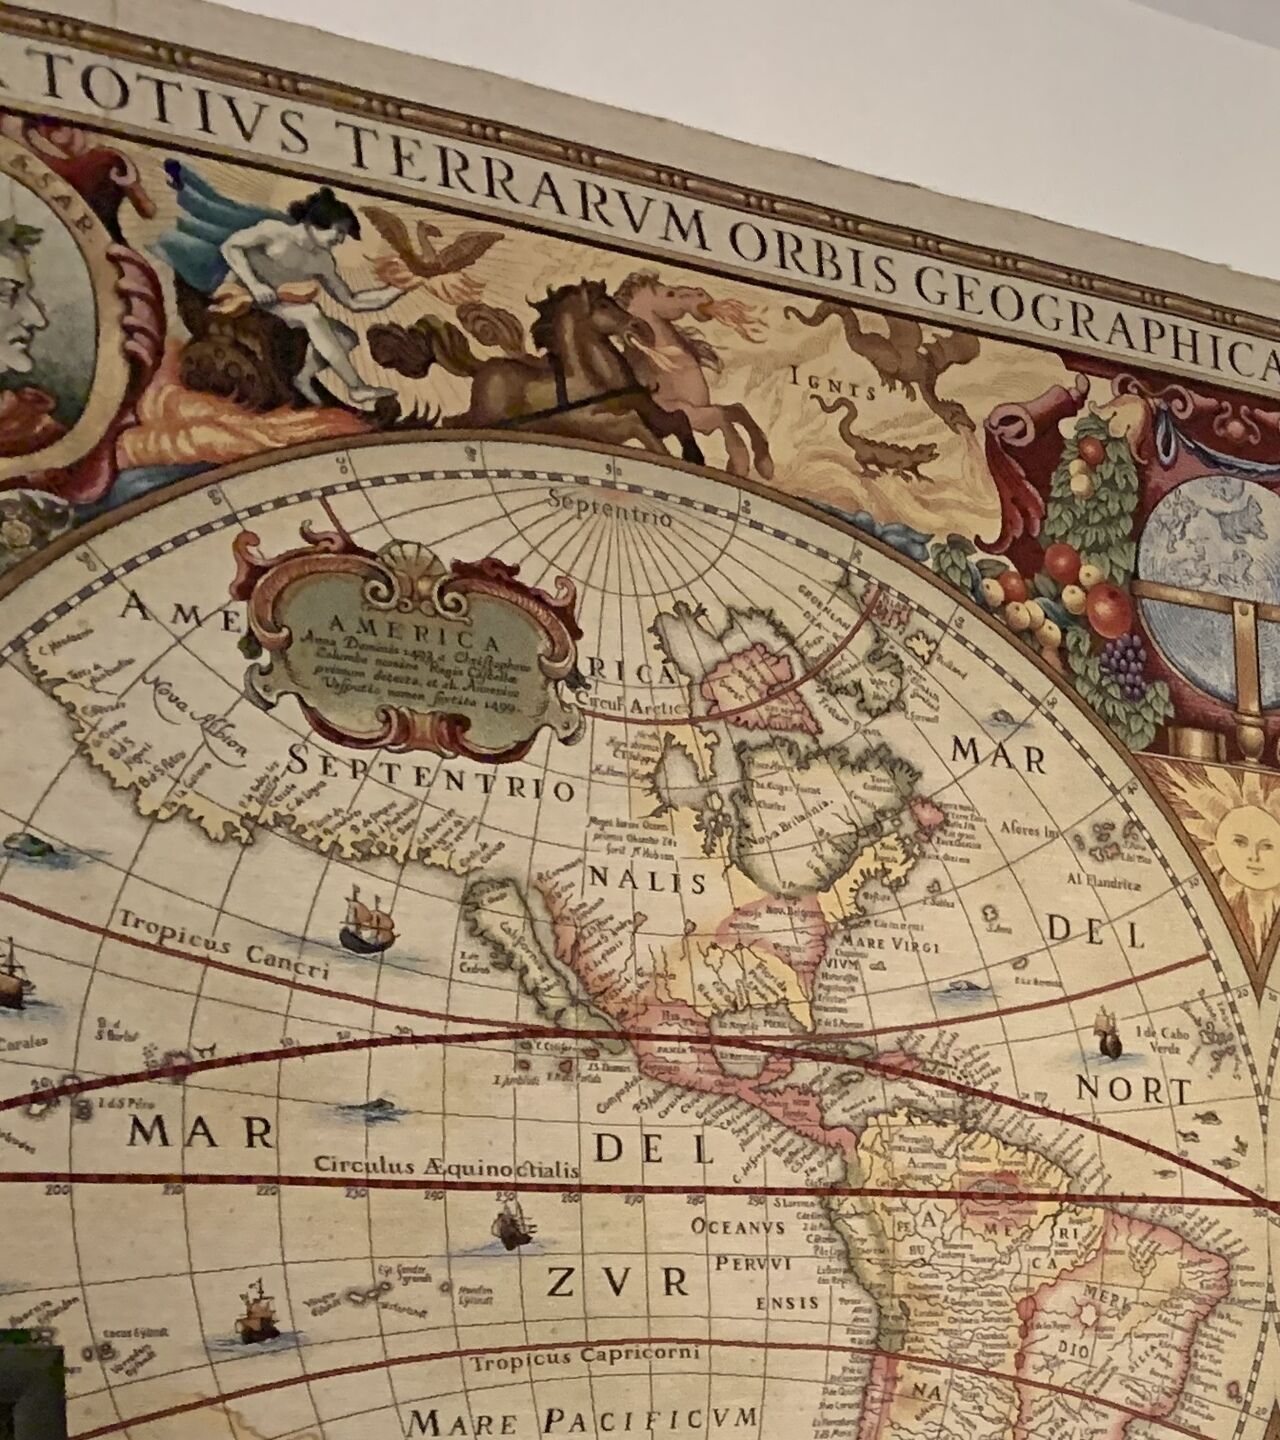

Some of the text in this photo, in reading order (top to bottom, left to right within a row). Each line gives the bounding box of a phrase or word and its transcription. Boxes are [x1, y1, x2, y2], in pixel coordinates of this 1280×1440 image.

[26, 48, 310, 154] TOTIVS
[334, 119, 713, 251] TERRARVM
[730, 221, 898, 294] ORBIS
[788, 363, 877, 402] IGNIS
[546, 489, 673, 529] Septentrio
[329, 614, 499, 652] AMERICA
[951, 733, 1047, 775] MAR
[588, 865, 706, 895] NALIS
[118, 908, 330, 981] Tropicus Cancri
[1046, 913, 1146, 949] DEL
[1075, 1073, 1193, 1106] NORT
[126, 1114, 274, 1148] MAR
[593, 1132, 714, 1165] DEL
[314, 1154, 580, 1180] Circulus Æquinoctialis
[691, 1216, 786, 1235] OCEANVS
[715, 1256, 792, 1272] PERVVI
[547, 1266, 690, 1298] ZVR
[756, 1295, 819, 1311] ENSIS
[470, 1344, 701, 1374] Tropicus Capricorni
[407, 1406, 758, 1439] MARE PACIFICVM
